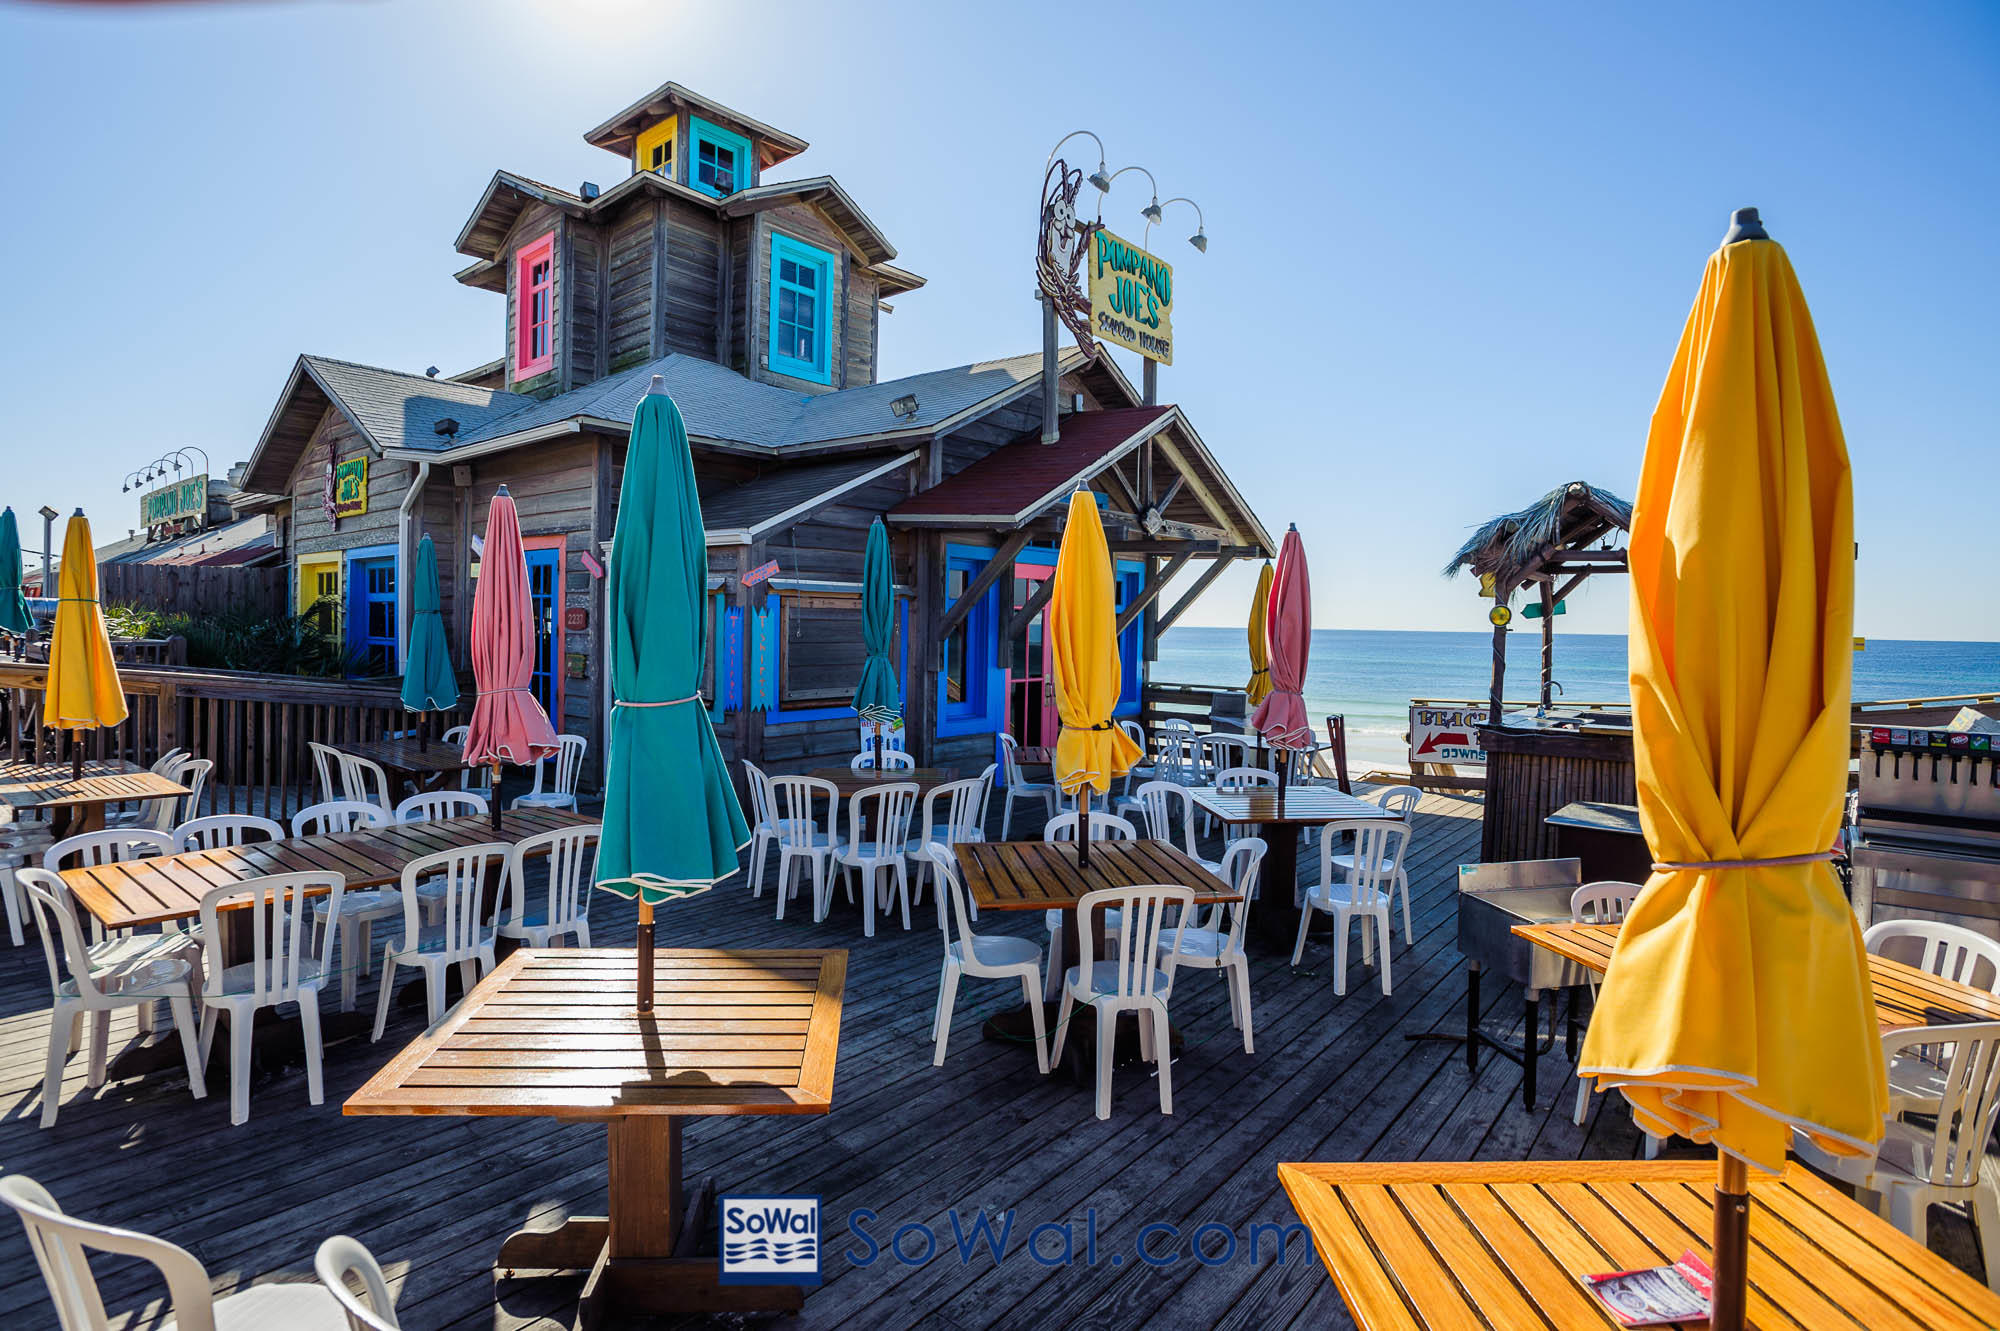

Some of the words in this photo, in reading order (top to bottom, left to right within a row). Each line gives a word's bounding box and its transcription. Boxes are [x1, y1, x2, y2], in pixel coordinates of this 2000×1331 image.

[1095, 230, 1171, 307] POMPANO
[1109, 276, 1159, 329] JOE'S
[1098, 311, 1136, 342] SEAFOOD
[1139, 331, 1169, 358] HOUSE
[178, 477, 203, 513] JOE'S
[1441, 748, 1488, 760] DOWNS
